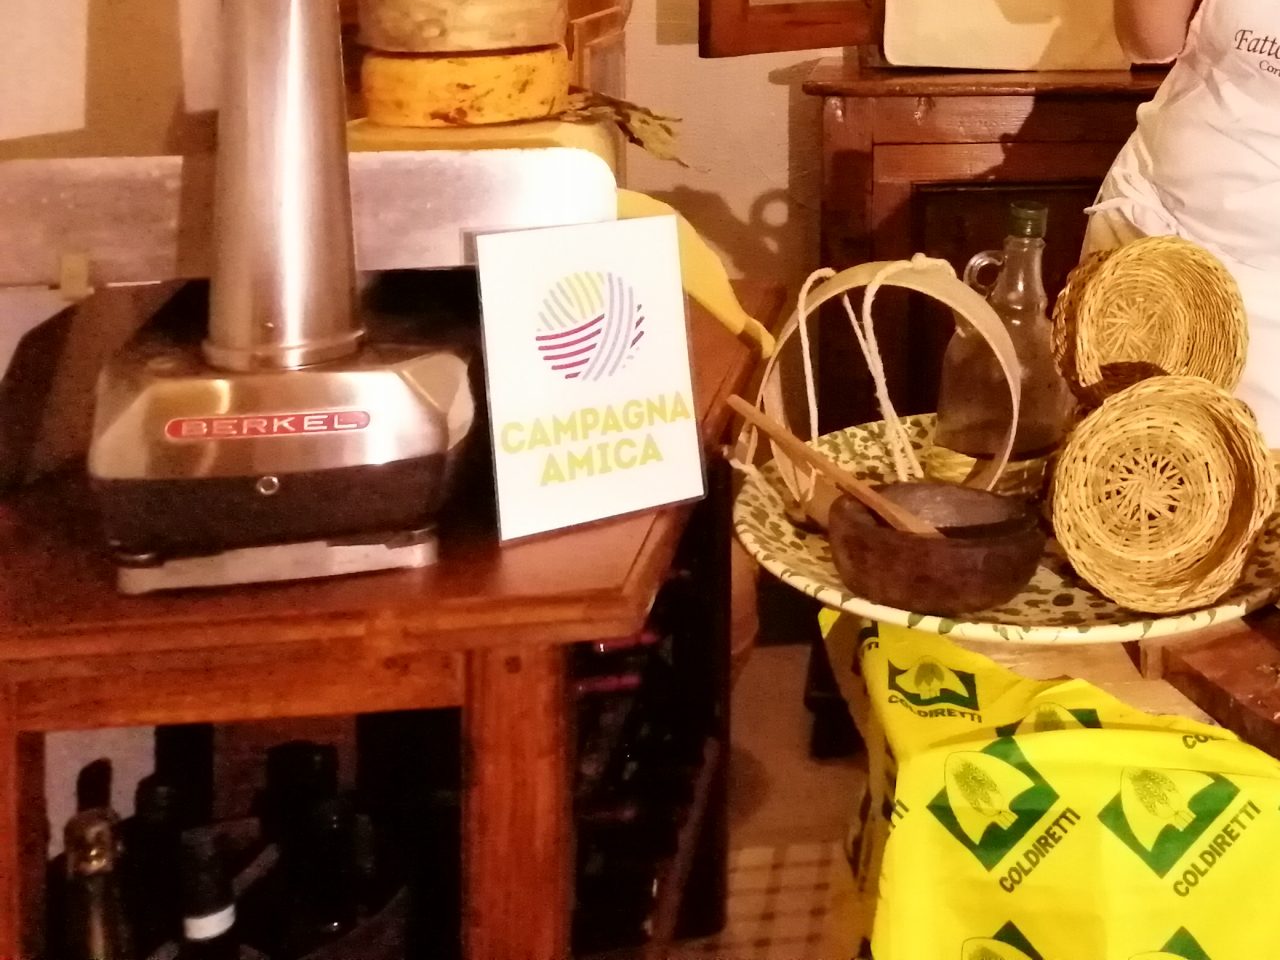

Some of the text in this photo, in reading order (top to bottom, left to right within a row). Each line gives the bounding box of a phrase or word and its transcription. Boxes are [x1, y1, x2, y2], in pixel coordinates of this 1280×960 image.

[180, 413, 359, 438] BERKEL
[500, 392, 692, 455] CAMPAGNA
[539, 433, 664, 488] AMICA
[999, 807, 1082, 895] COLDIRETTI
[1172, 800, 1262, 899] COLDIRETTI
